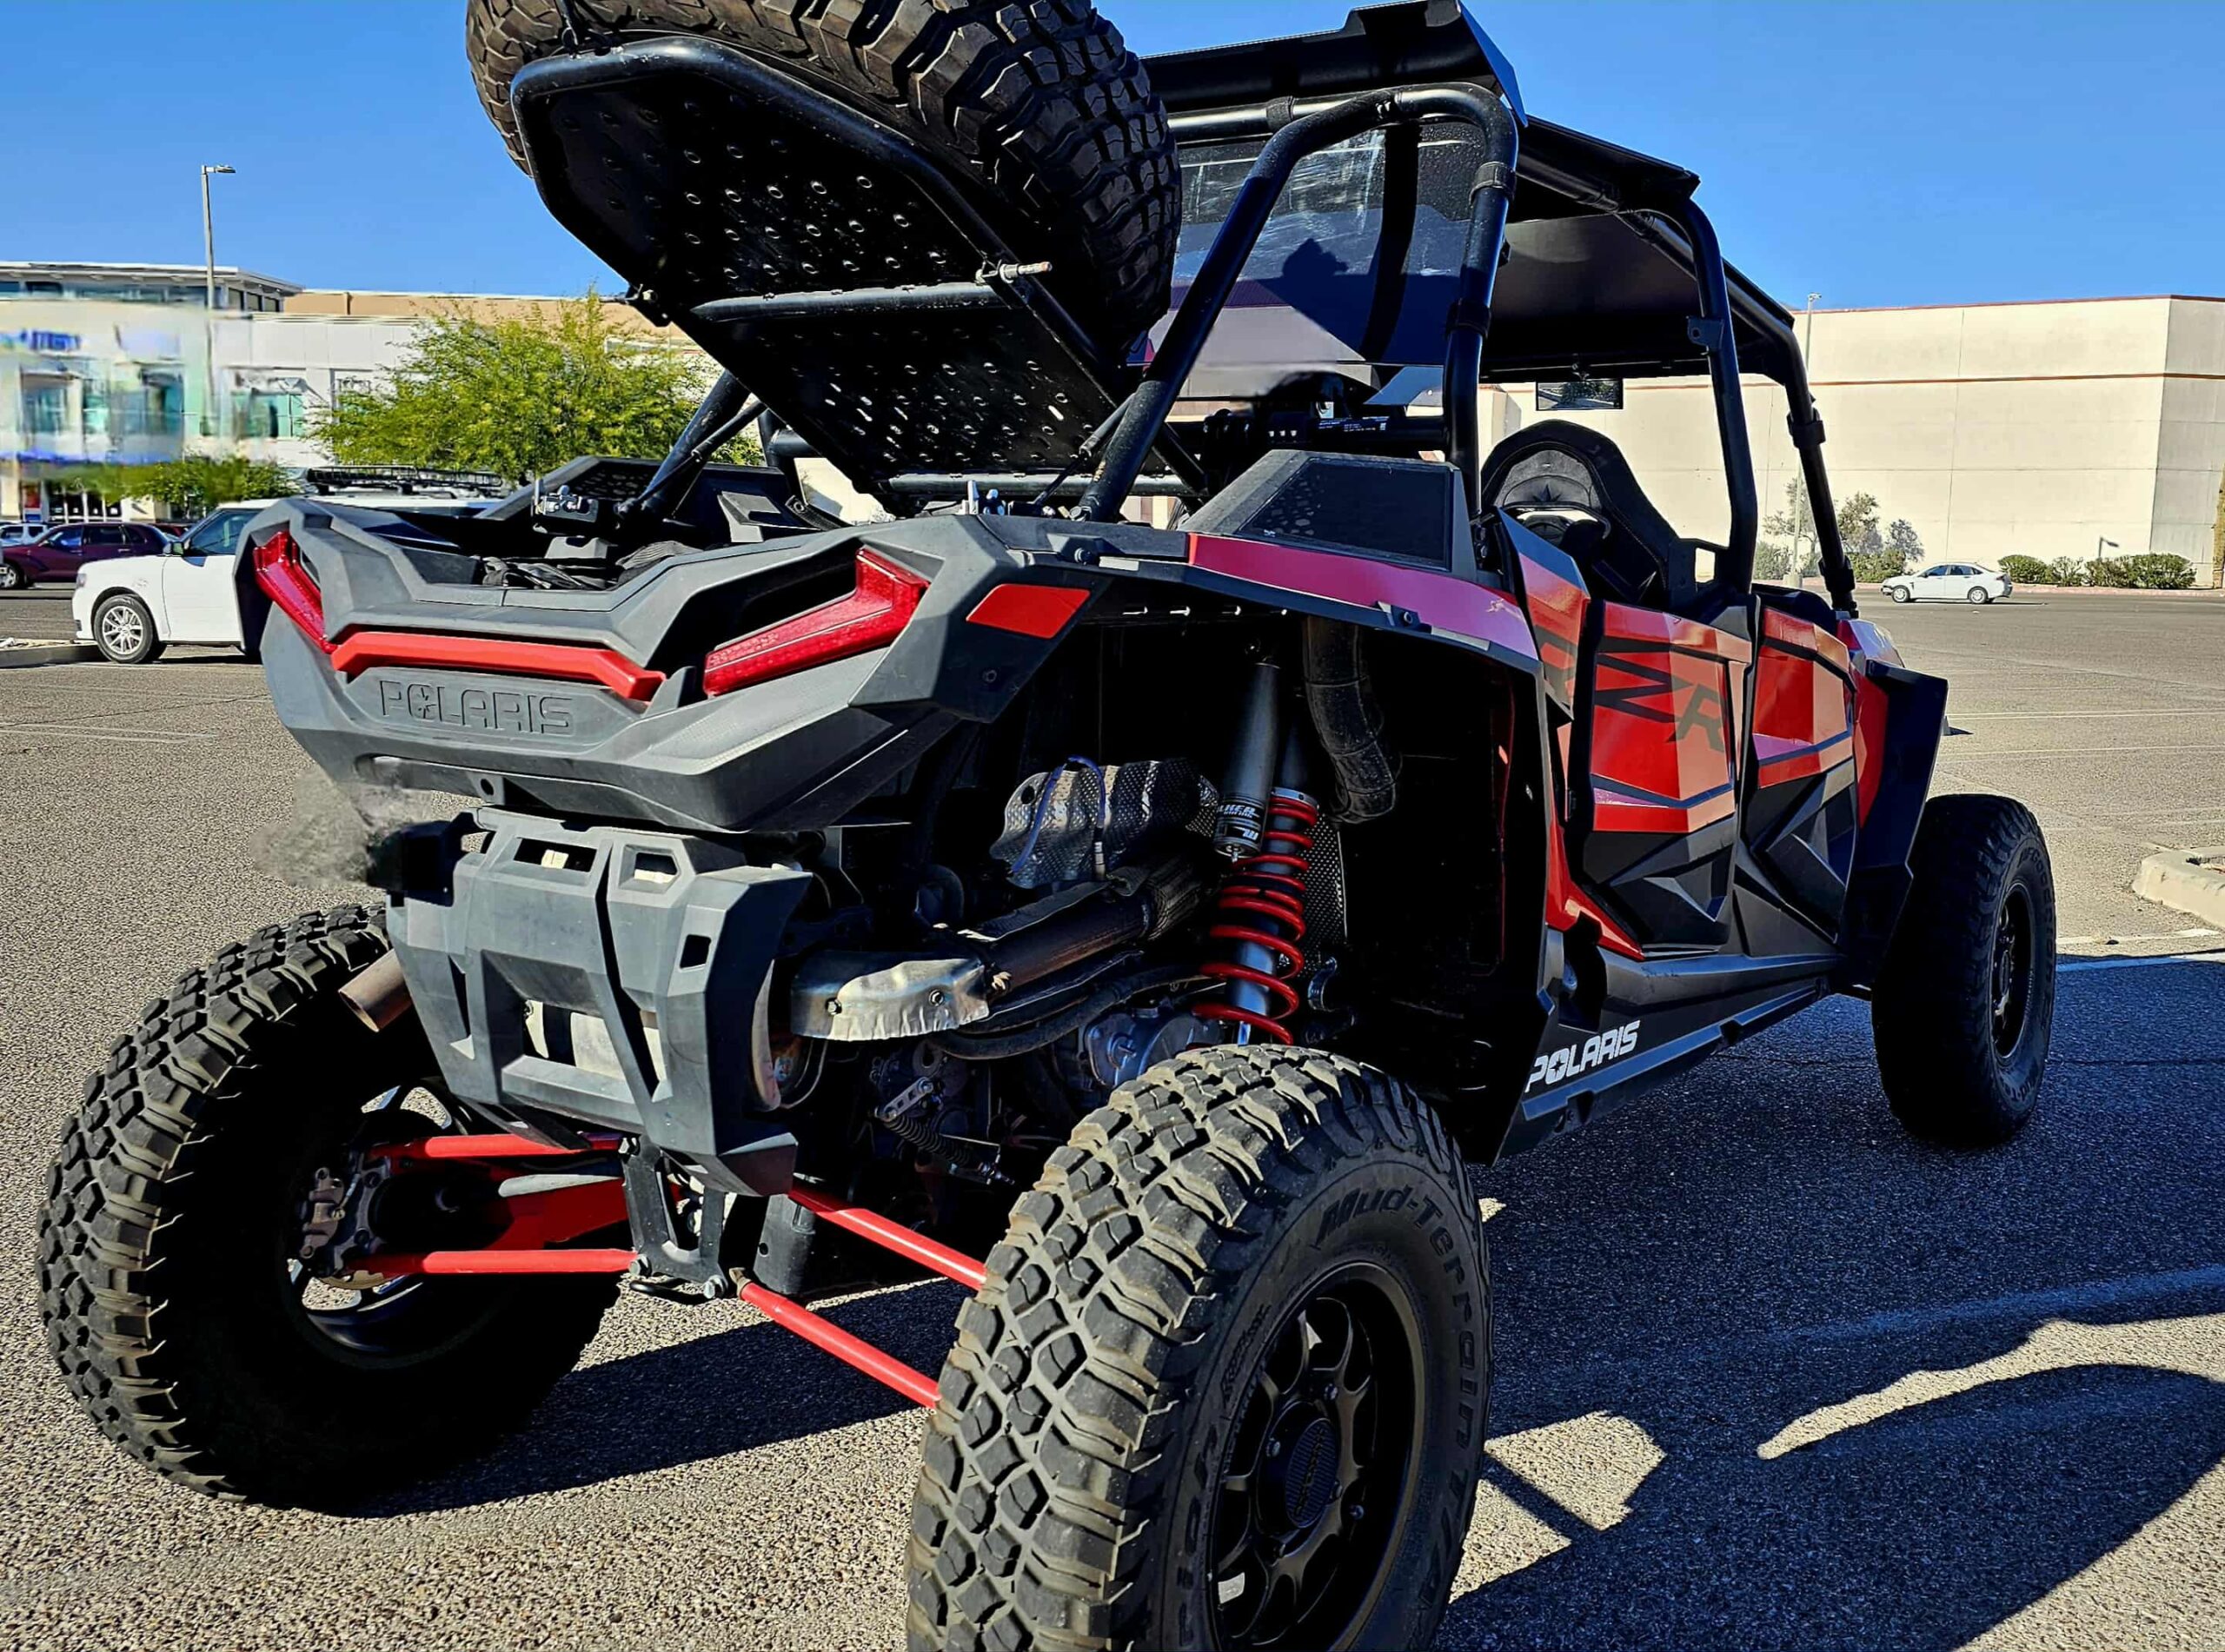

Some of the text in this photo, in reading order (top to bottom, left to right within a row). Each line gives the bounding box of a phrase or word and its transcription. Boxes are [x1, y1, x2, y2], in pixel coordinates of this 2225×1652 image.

[379, 680, 575, 738] POLARIS
[1524, 1019, 1641, 1093] POLARIS
[1311, 1184, 1478, 1449] Mud-Terrain
